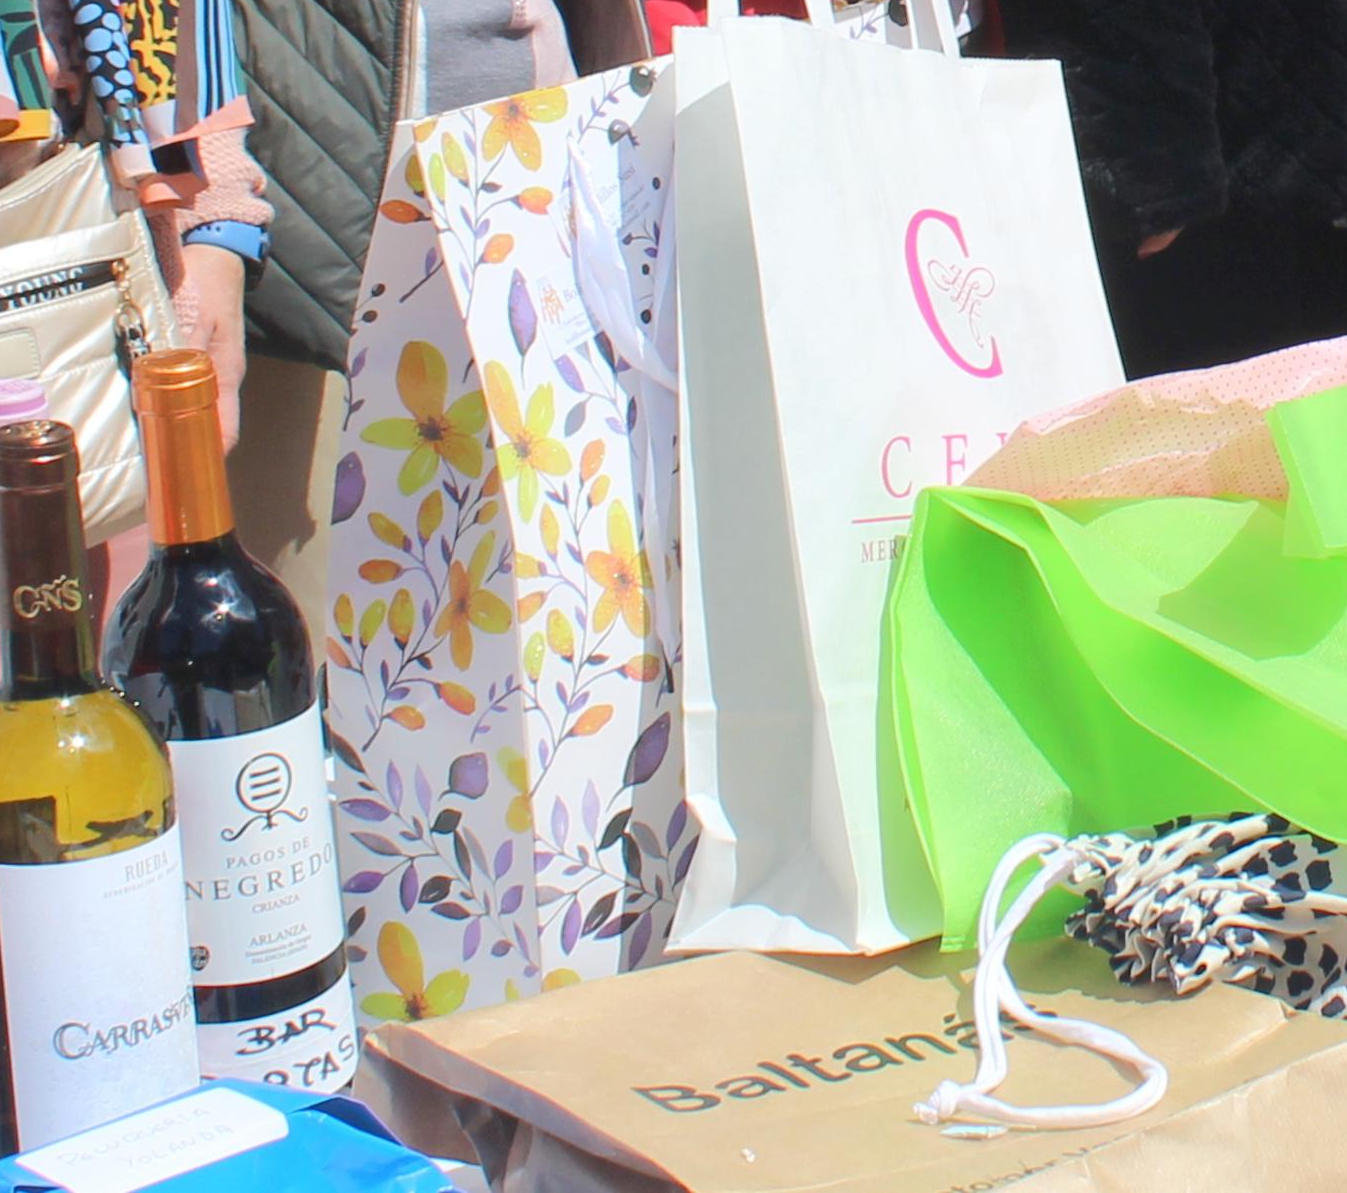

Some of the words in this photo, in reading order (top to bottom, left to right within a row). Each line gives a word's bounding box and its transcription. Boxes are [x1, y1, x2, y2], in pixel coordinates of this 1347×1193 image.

[861, 538, 905, 563] MER
[226, 846, 285, 869] PAGOS
[292, 837, 310, 853] DE
[184, 842, 332, 901] NEGREDO
[249, 923, 307, 947] ARLANZA
[235, 1007, 337, 1055] BAR
